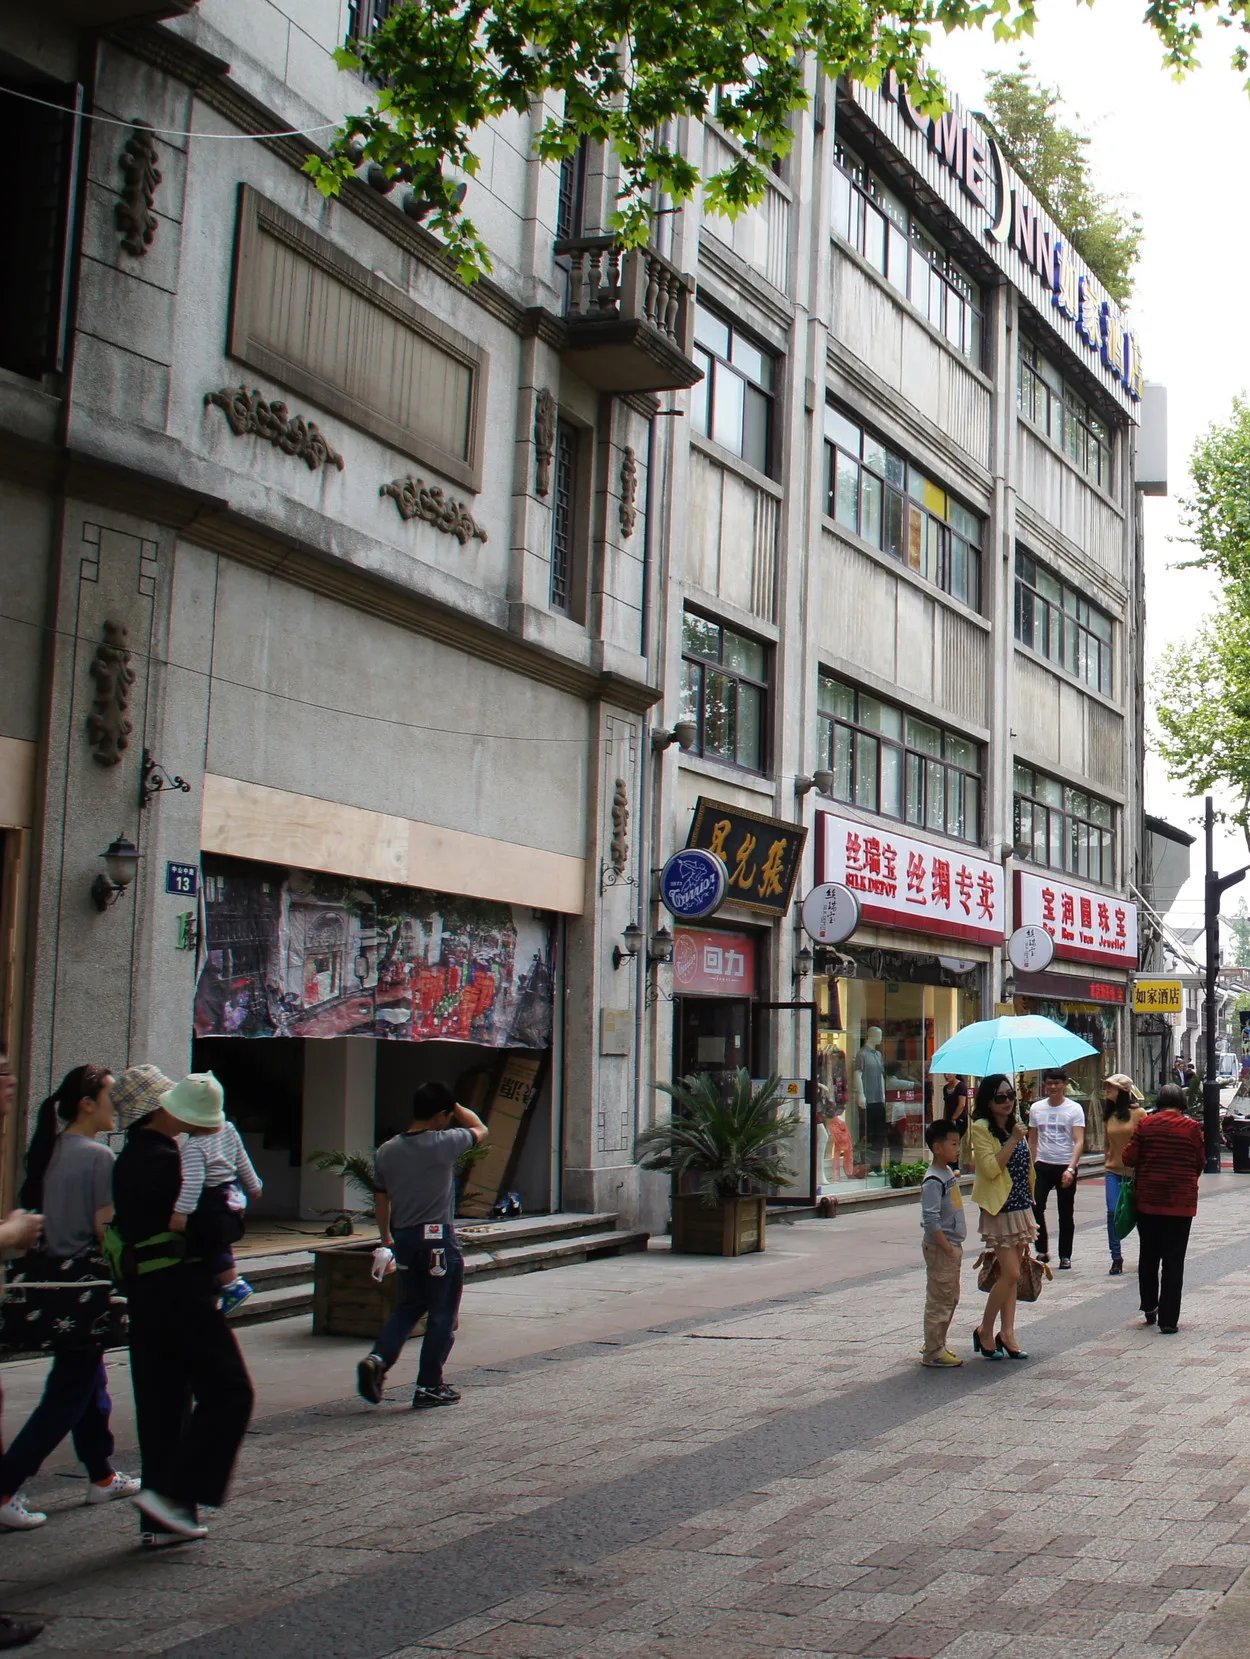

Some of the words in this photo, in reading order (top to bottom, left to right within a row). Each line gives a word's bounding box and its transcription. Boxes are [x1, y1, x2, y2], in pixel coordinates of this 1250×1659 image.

[176, 876, 190, 891] 13
[845, 831, 898, 881] 丝瑞宝
[905, 850, 995, 922] 丝绸专卖
[703, 944, 745, 978] 回力
[1135, 984, 1180, 1005] 如家酒店
